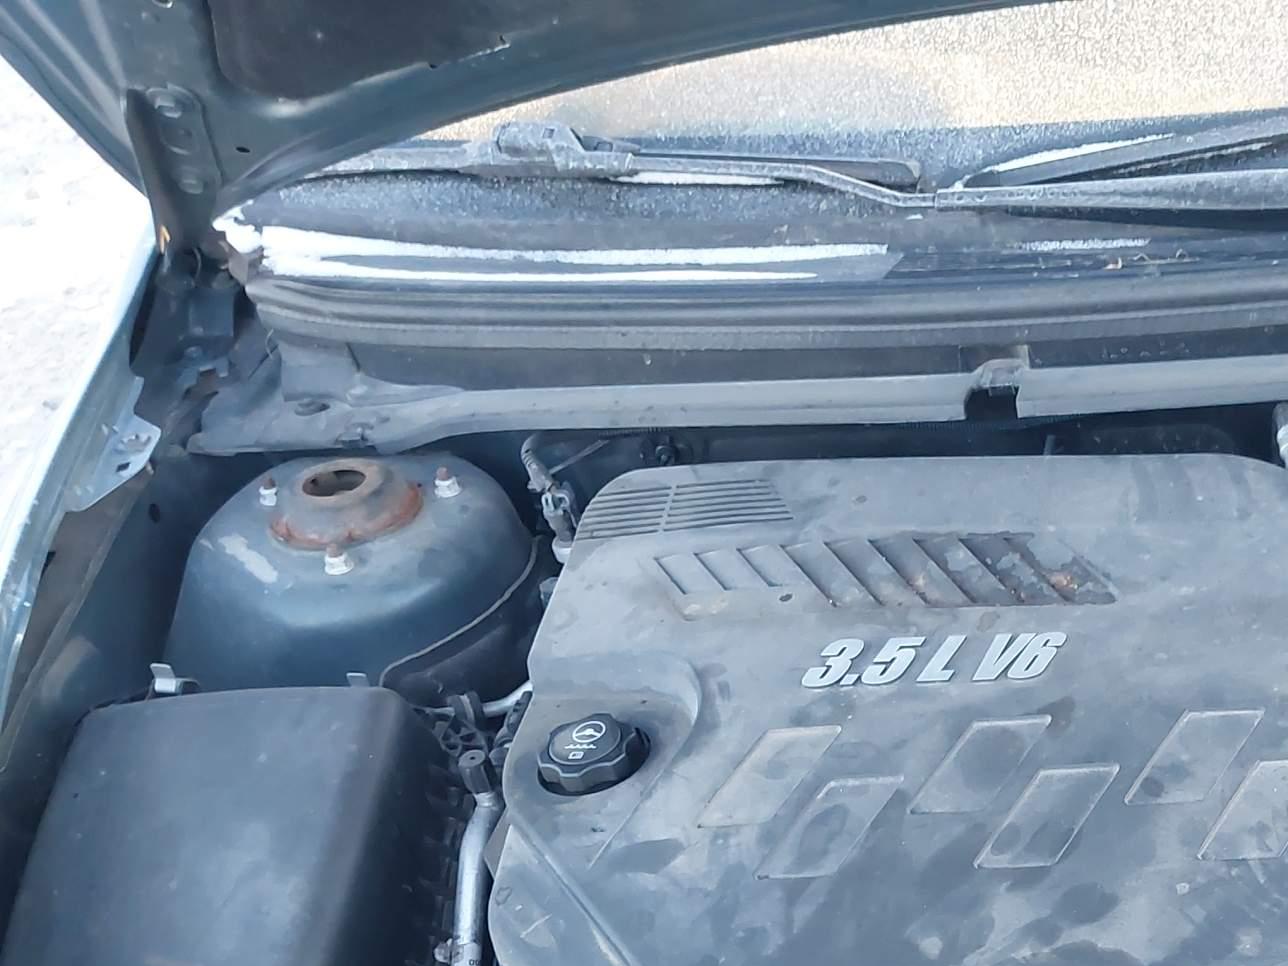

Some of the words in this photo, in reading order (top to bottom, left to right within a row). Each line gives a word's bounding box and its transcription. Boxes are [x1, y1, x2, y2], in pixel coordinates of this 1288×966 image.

[801, 637, 926, 688] 3.5
[916, 635, 967, 682] L
[971, 631, 1067, 681] V6
